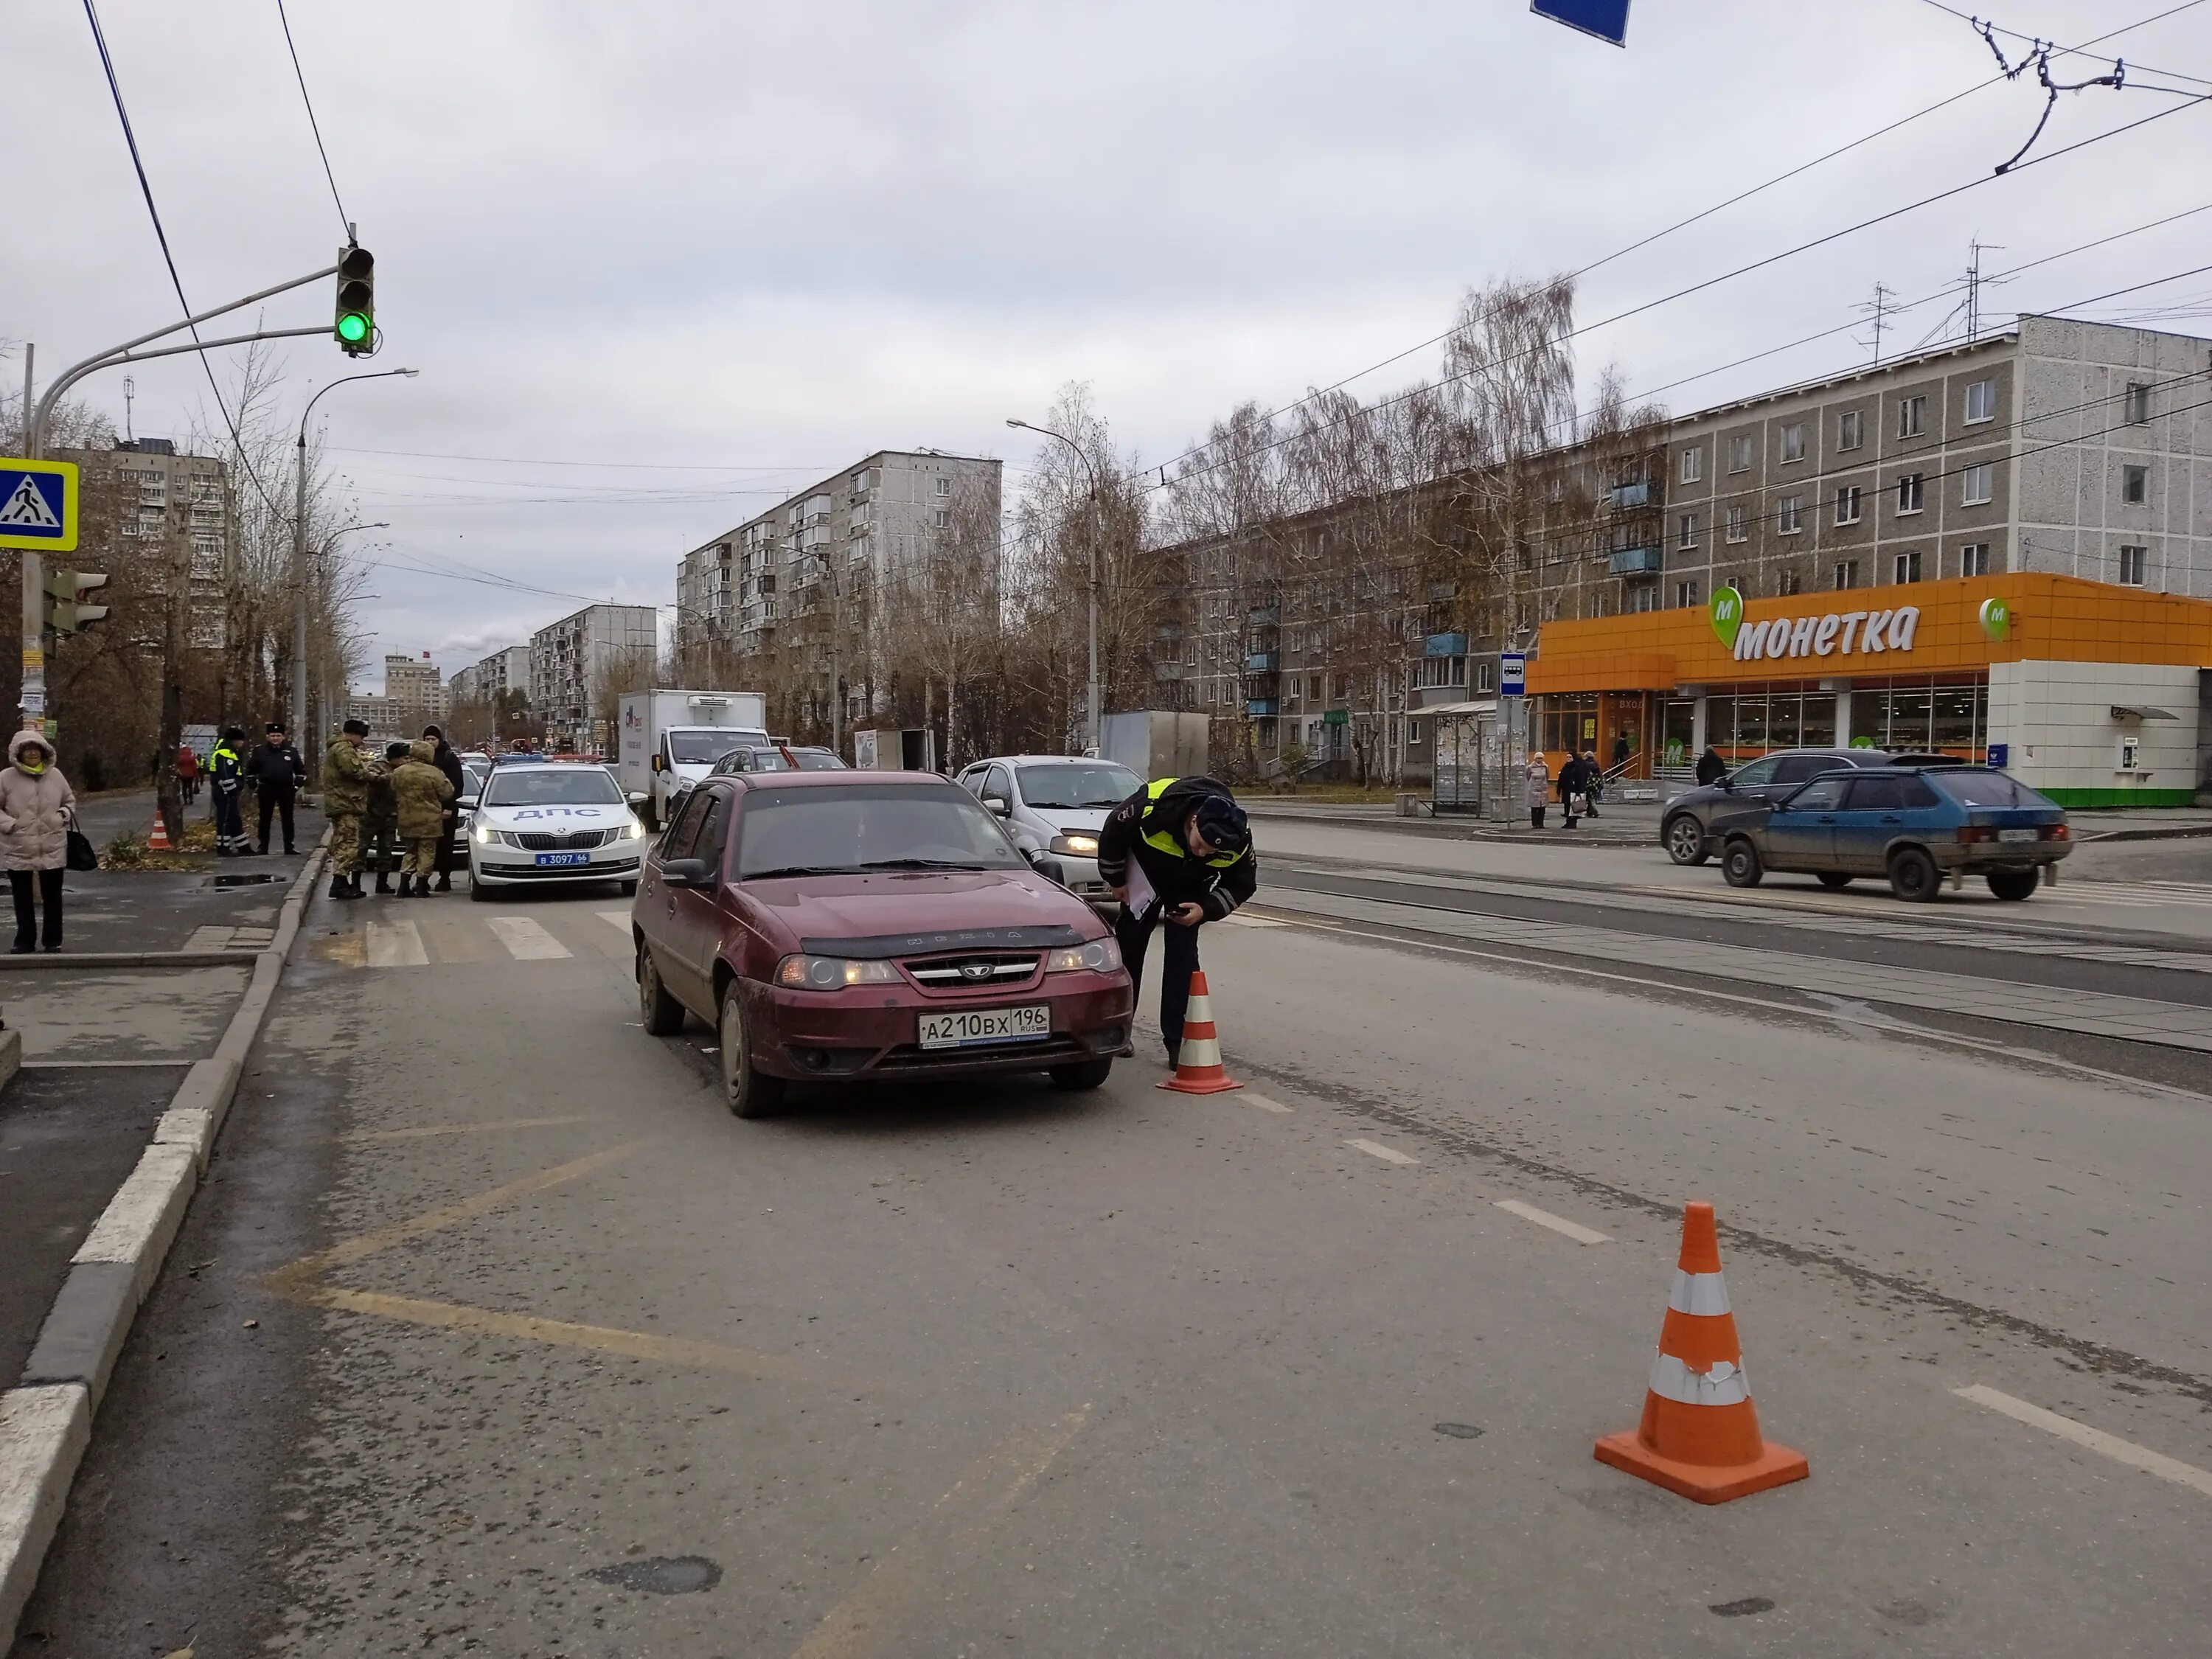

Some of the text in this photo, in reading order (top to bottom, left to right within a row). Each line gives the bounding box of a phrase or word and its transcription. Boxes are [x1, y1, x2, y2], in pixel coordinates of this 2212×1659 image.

[1619, 700, 1644, 709] ВХОД
[513, 808, 602, 821] ДПС
[549, 855, 573, 864] 3097
[926, 1014, 1009, 1040] А210ВХ
[1013, 1008, 1044, 1026] 196
